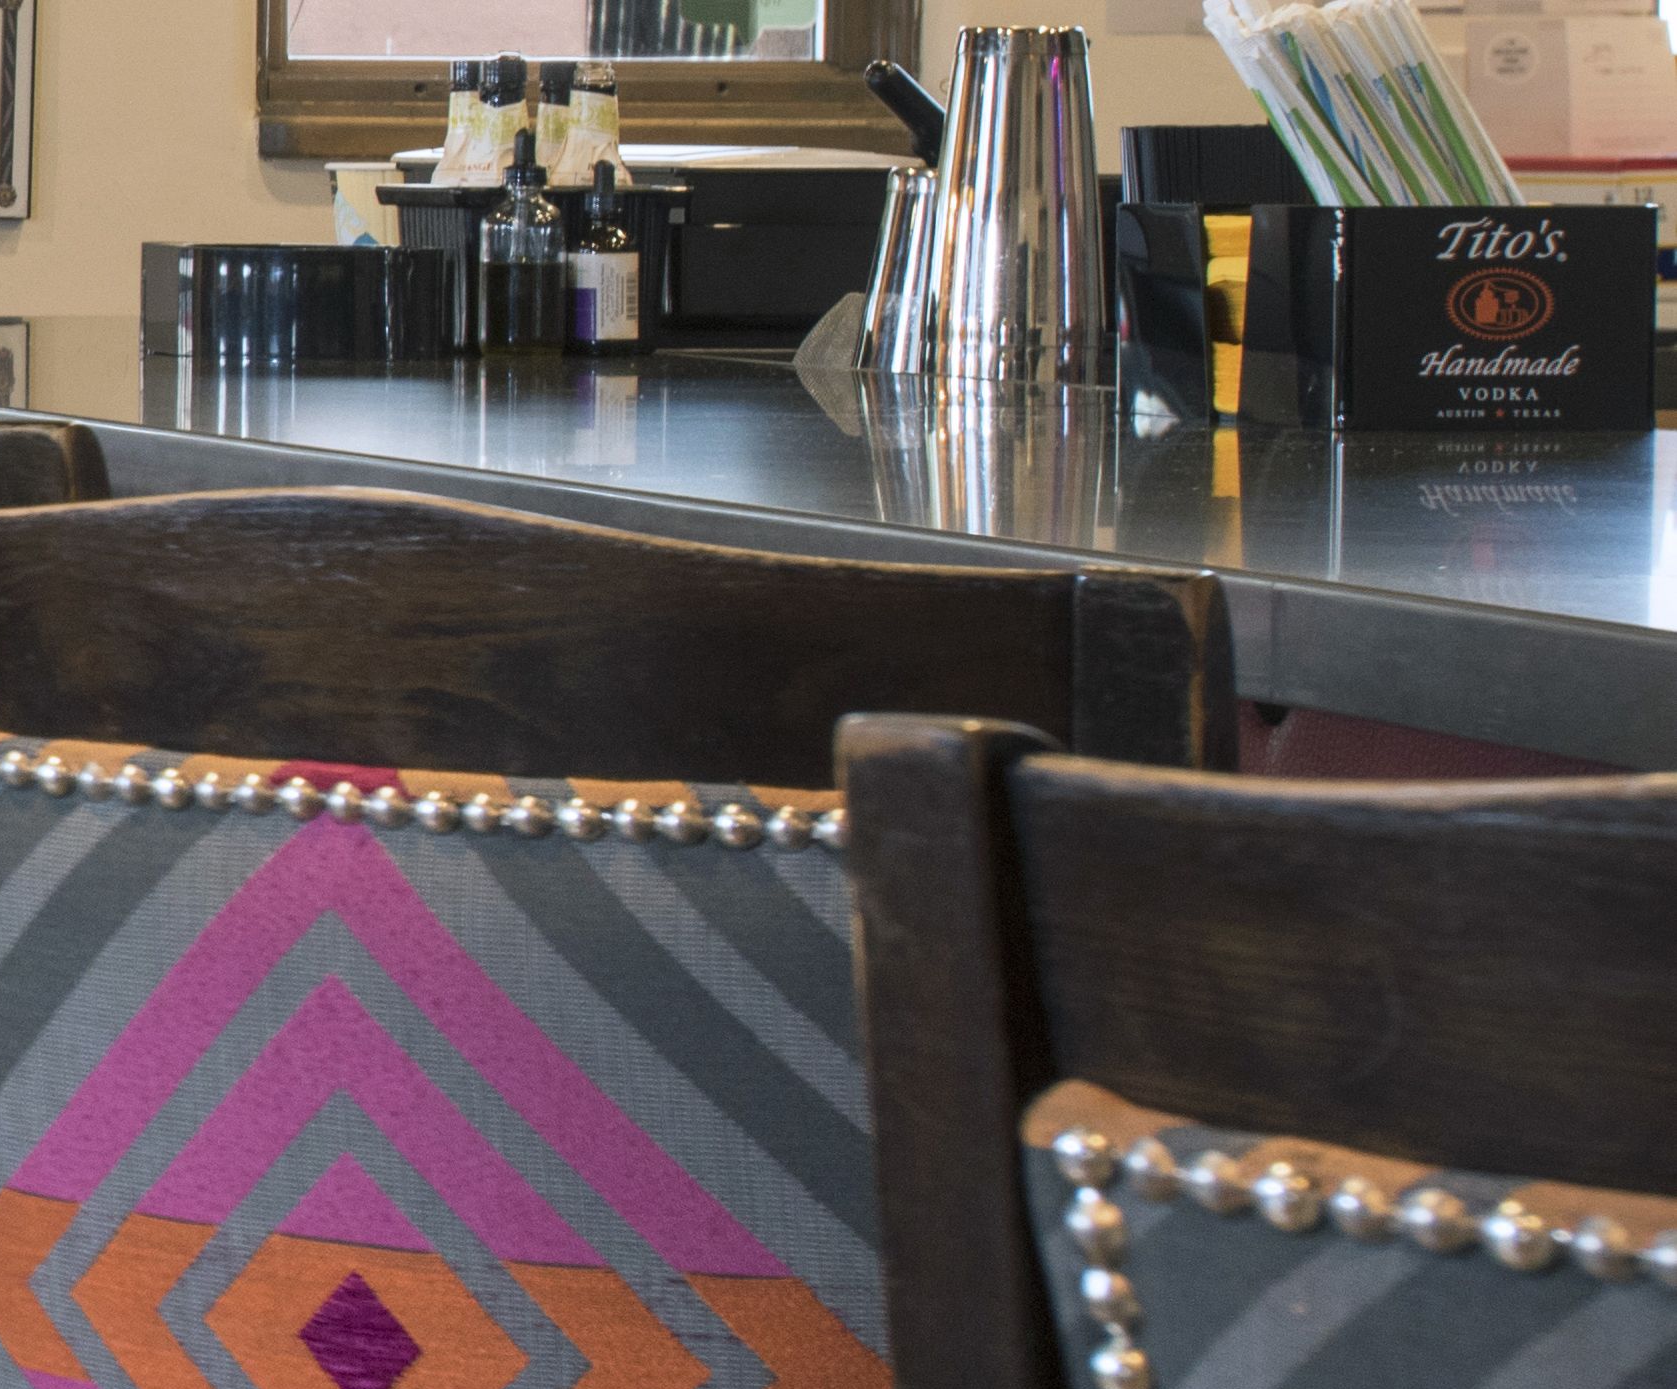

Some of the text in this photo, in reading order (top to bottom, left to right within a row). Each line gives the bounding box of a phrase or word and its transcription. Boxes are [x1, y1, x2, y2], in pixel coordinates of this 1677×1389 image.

[1419, 344, 1580, 377] Handmade
[1459, 387, 1539, 401] VODKA
[1436, 409, 1561, 418] AUSTIN TEXAS
